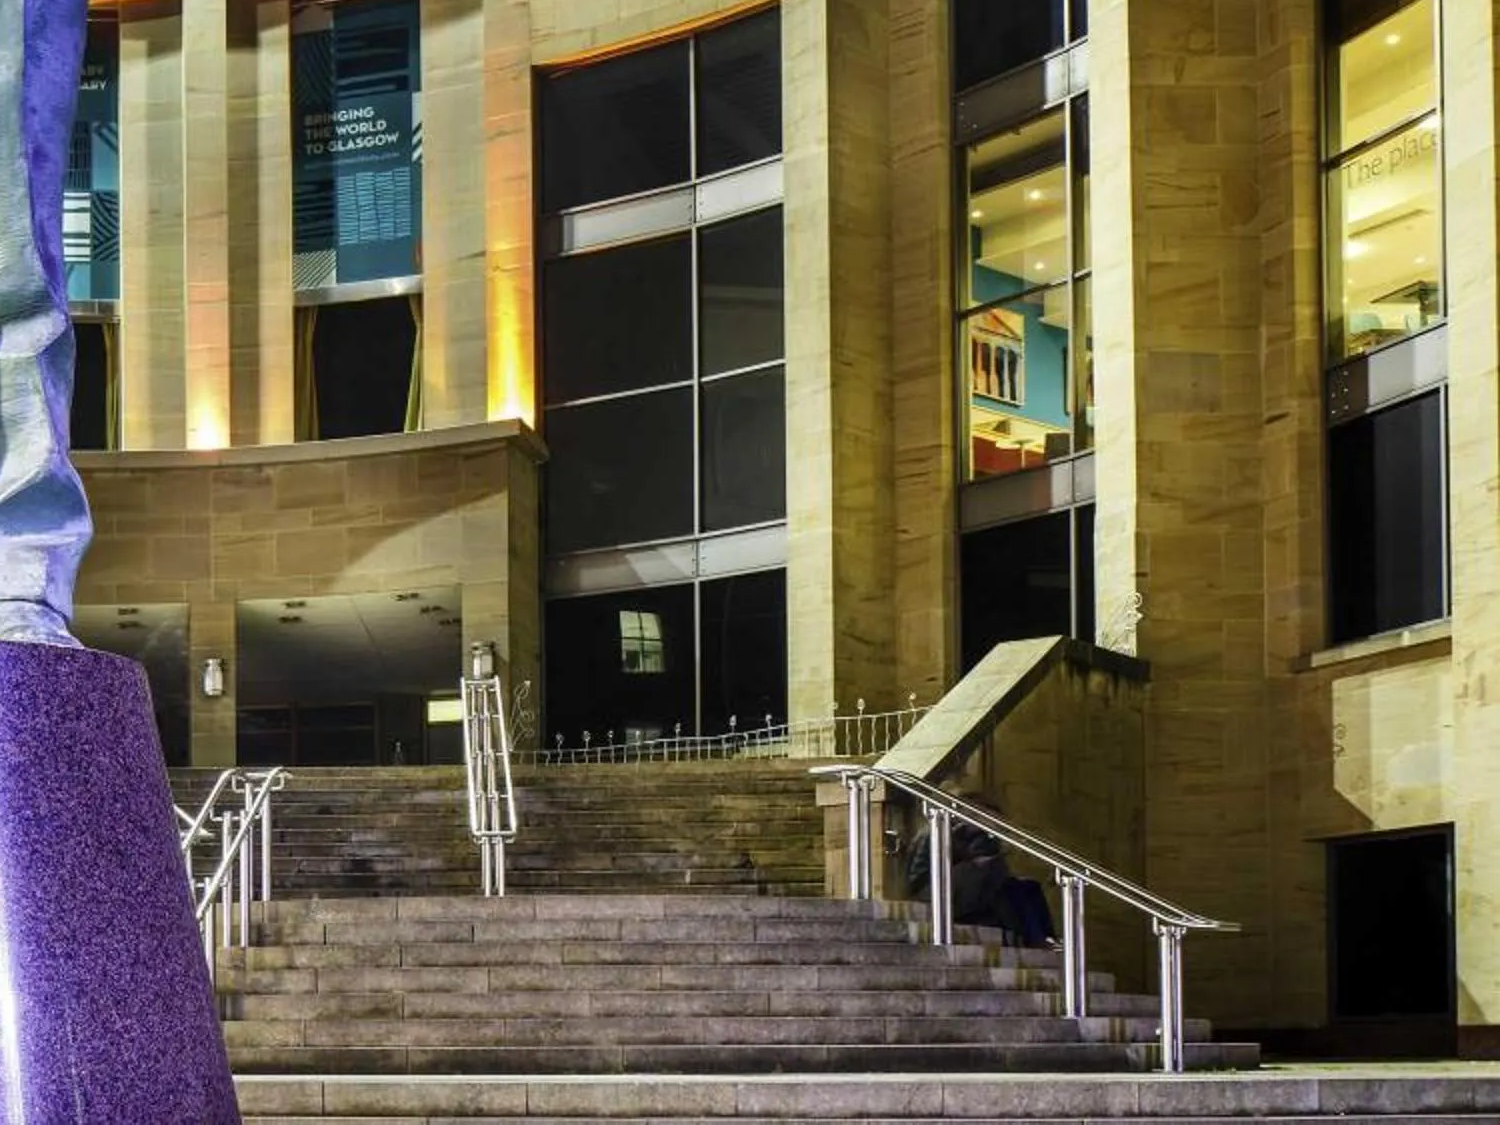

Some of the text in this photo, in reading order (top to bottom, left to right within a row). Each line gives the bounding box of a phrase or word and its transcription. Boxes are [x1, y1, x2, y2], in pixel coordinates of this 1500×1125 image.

[303, 106, 375, 126] BRINGING
[304, 118, 388, 141] THE WORLD
[304, 130, 400, 156] TO GLASGOW
